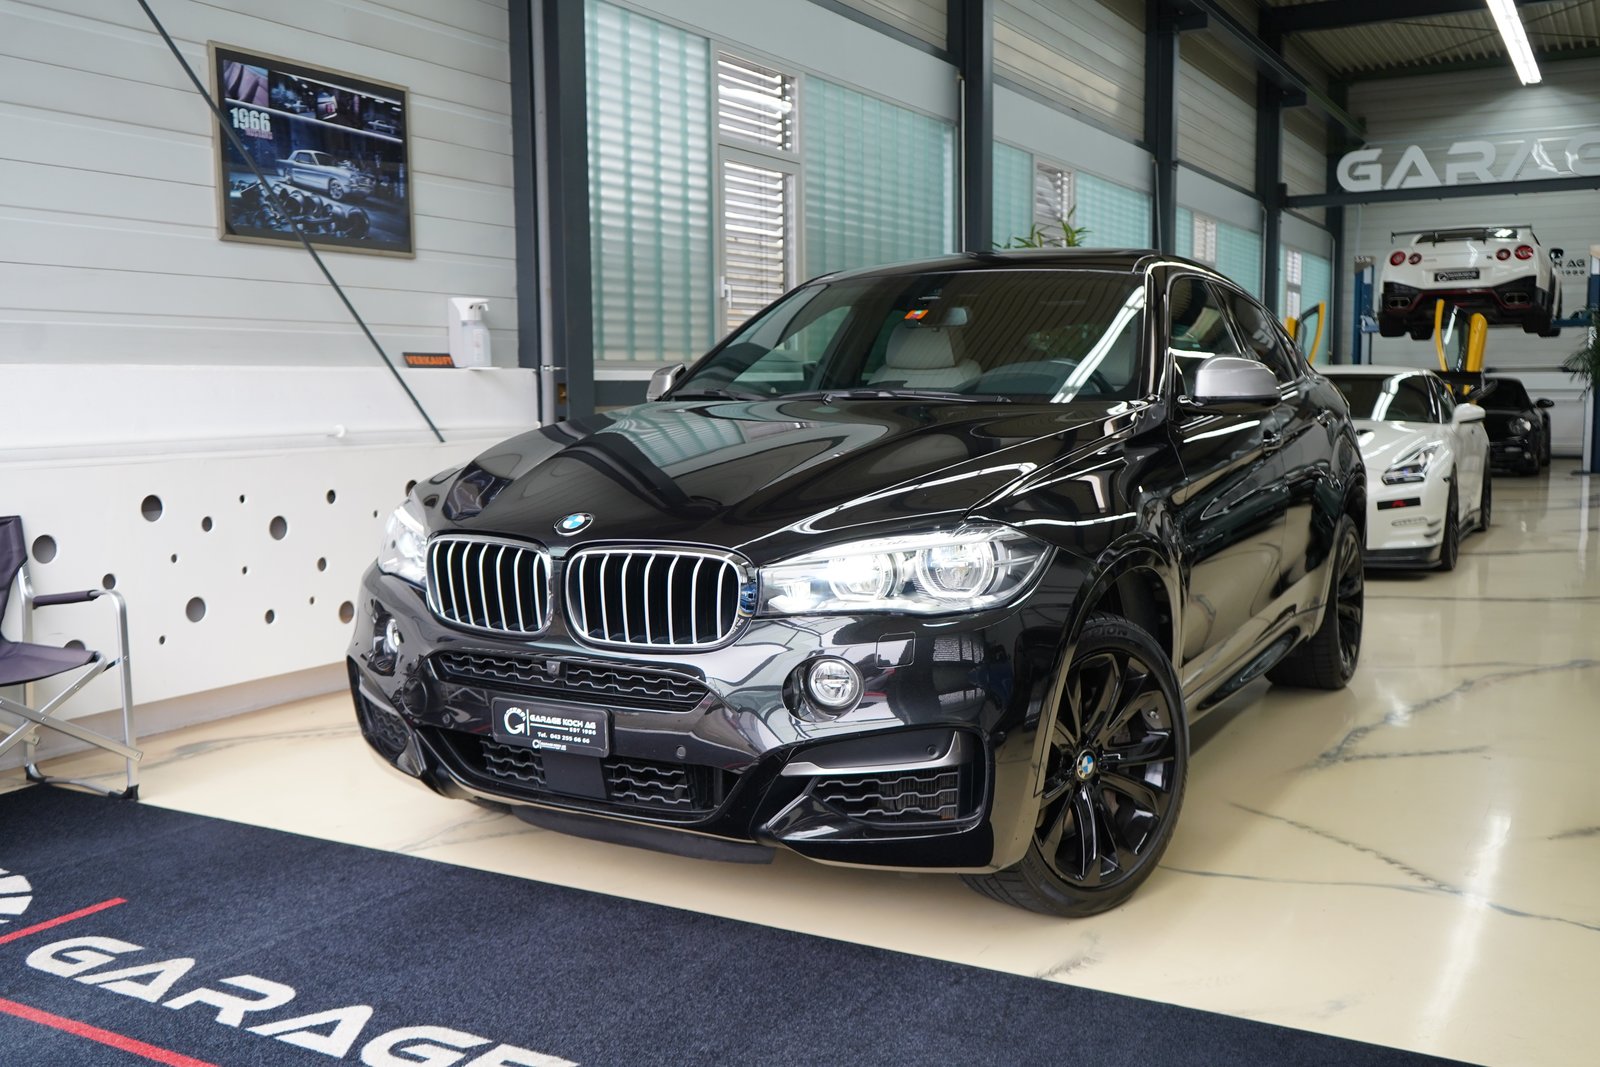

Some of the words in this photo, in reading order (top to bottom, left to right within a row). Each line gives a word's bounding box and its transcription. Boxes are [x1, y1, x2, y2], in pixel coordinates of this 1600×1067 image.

[230, 107, 271, 132] 1966
[530, 714, 561, 724] GARAGE
[562, 718, 583, 727] KOCH
[584, 721, 596, 729] AG
